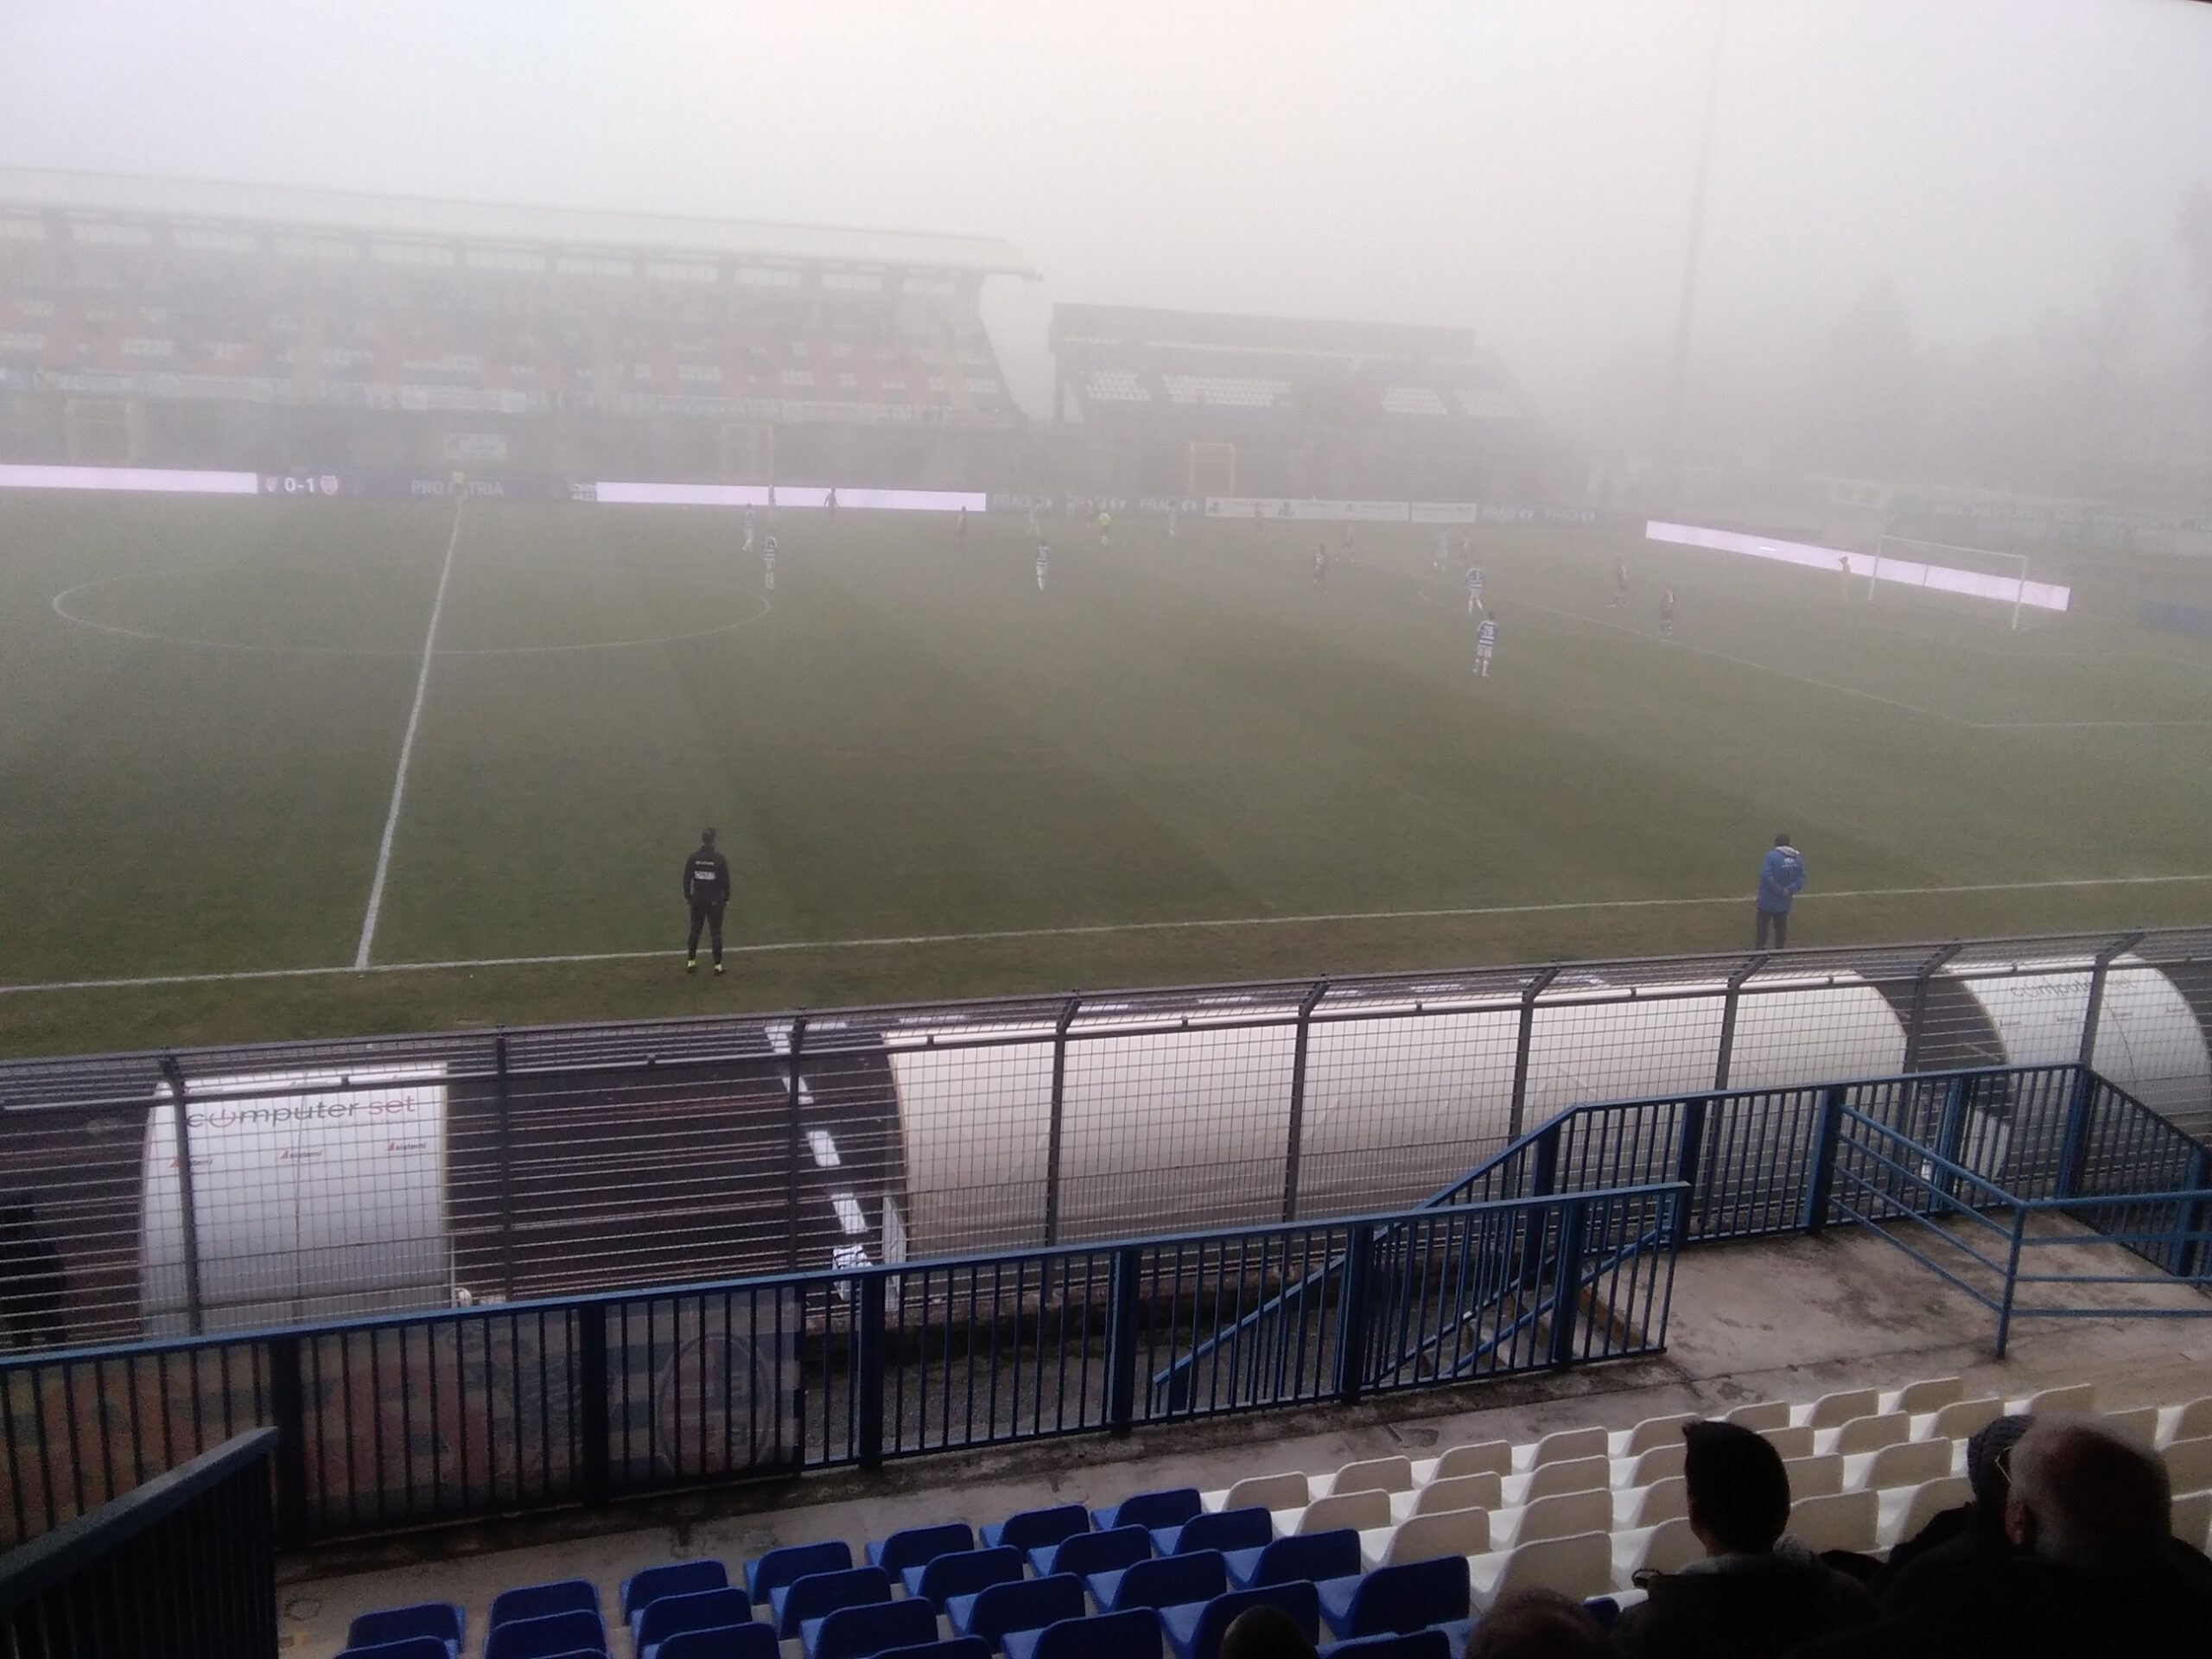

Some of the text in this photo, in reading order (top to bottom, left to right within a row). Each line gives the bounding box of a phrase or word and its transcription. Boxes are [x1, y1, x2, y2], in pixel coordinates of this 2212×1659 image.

[284, 477, 316, 493] 0-1
[410, 479, 505, 497] PRO PTRIA
[187, 1095, 416, 1128] computer set
